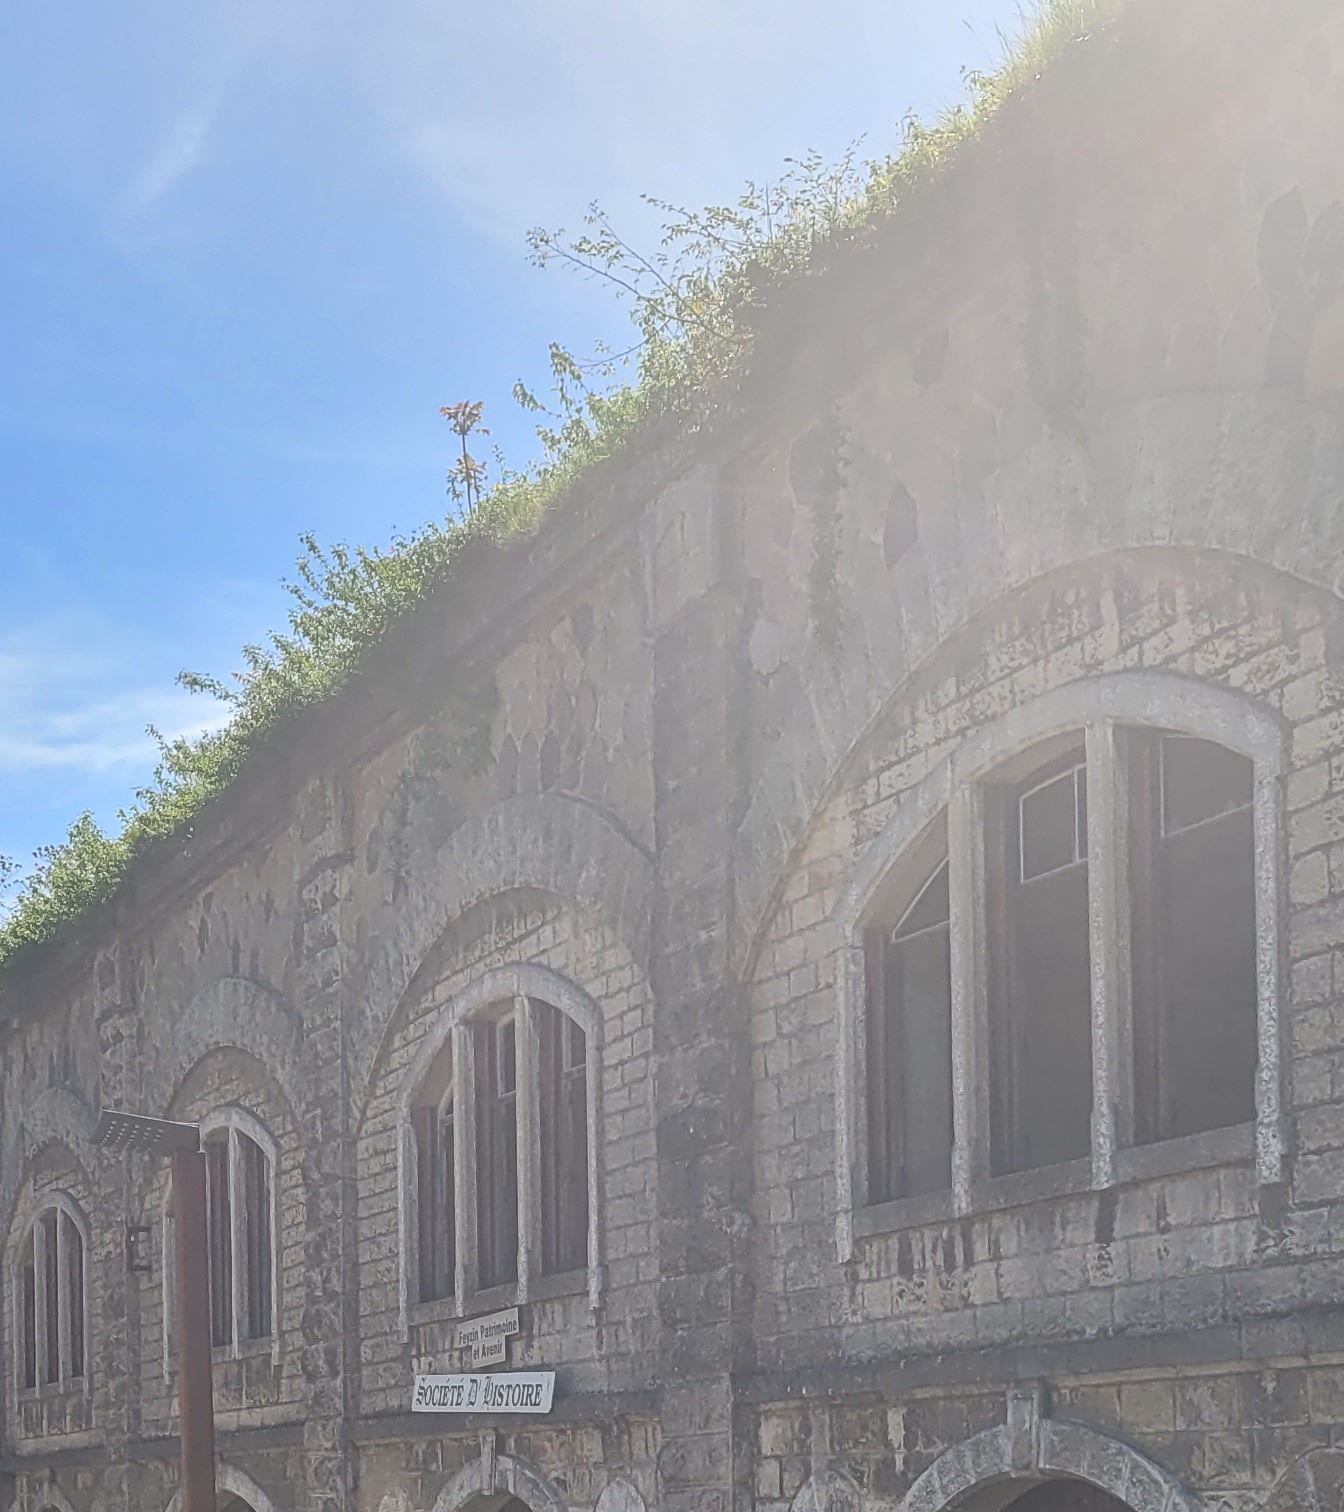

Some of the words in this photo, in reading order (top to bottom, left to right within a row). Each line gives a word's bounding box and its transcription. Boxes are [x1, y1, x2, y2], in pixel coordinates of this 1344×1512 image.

[459, 1327, 479, 1346] Feyzin
[480, 1318, 518, 1340] Patrimoine
[473, 1346, 480, 1361] et
[481, 1339, 503, 1359] Avenir
